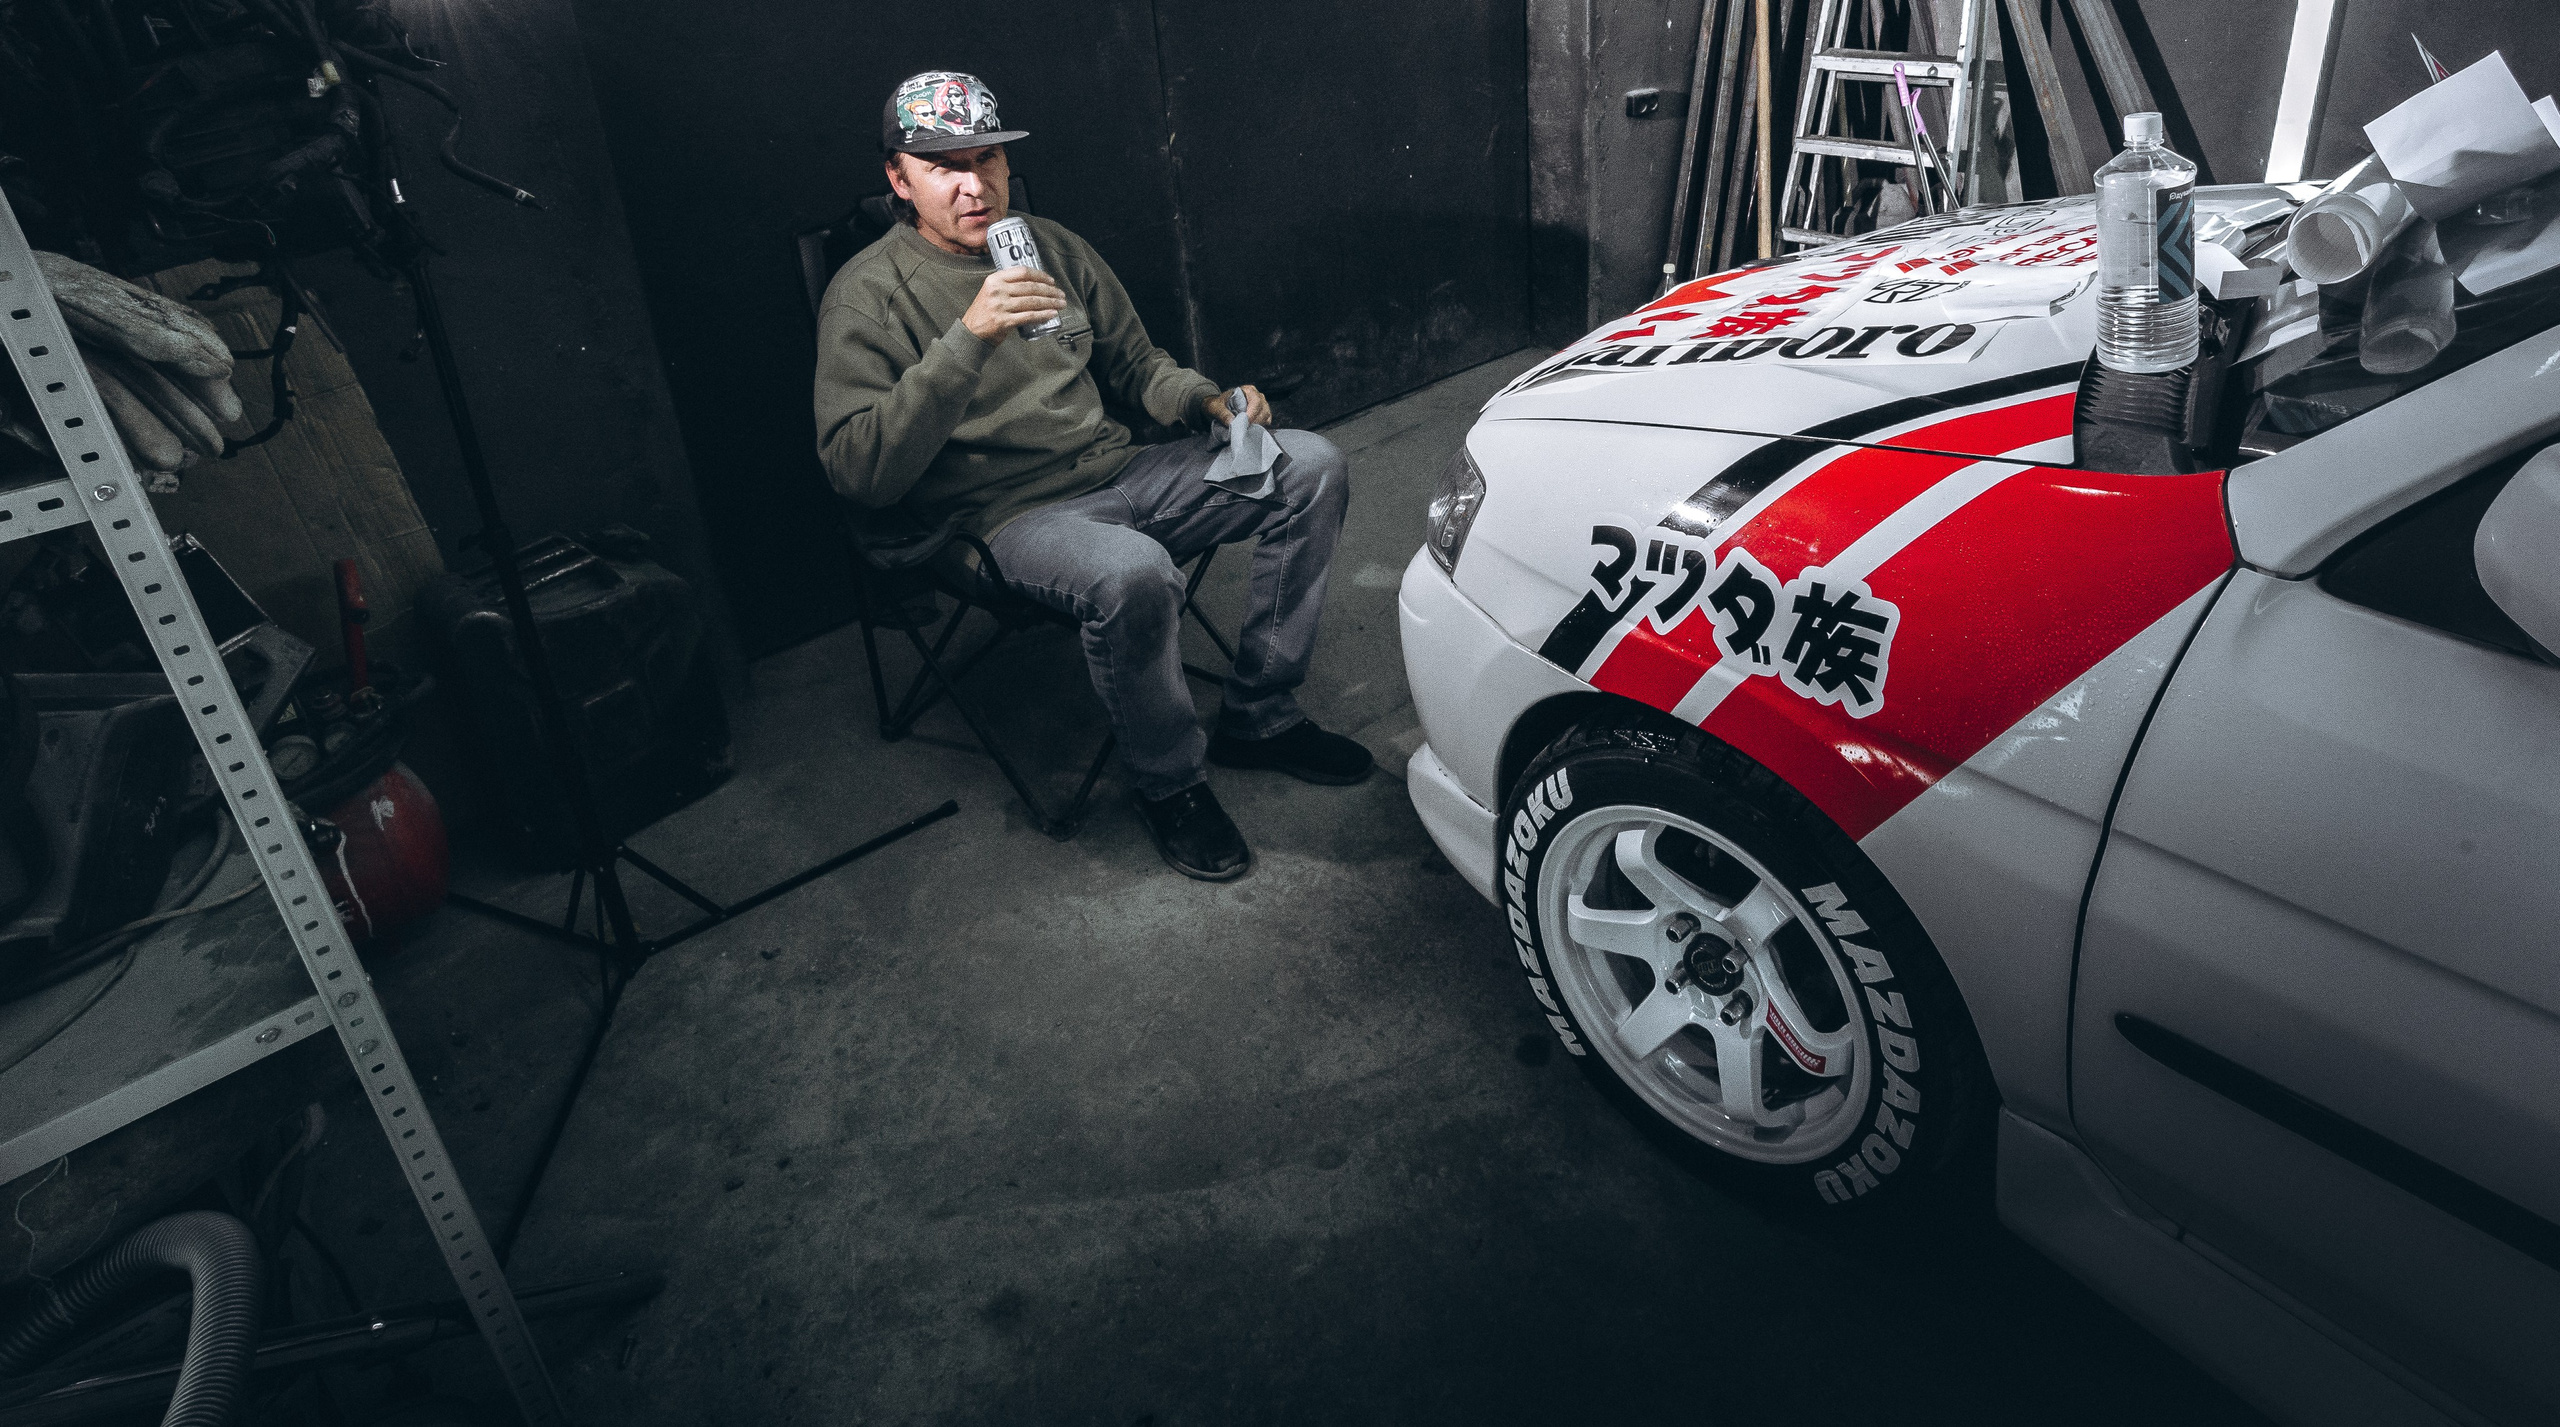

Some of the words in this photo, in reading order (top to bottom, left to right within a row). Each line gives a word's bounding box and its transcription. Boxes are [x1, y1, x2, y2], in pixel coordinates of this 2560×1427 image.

[2015, 233, 2097, 267] RECA
[1591, 525, 1890, 707] マツダ族
[1503, 767, 1586, 1057] MAZDAZOKU
[1801, 882, 1921, 1205] MAZDAZOKU
